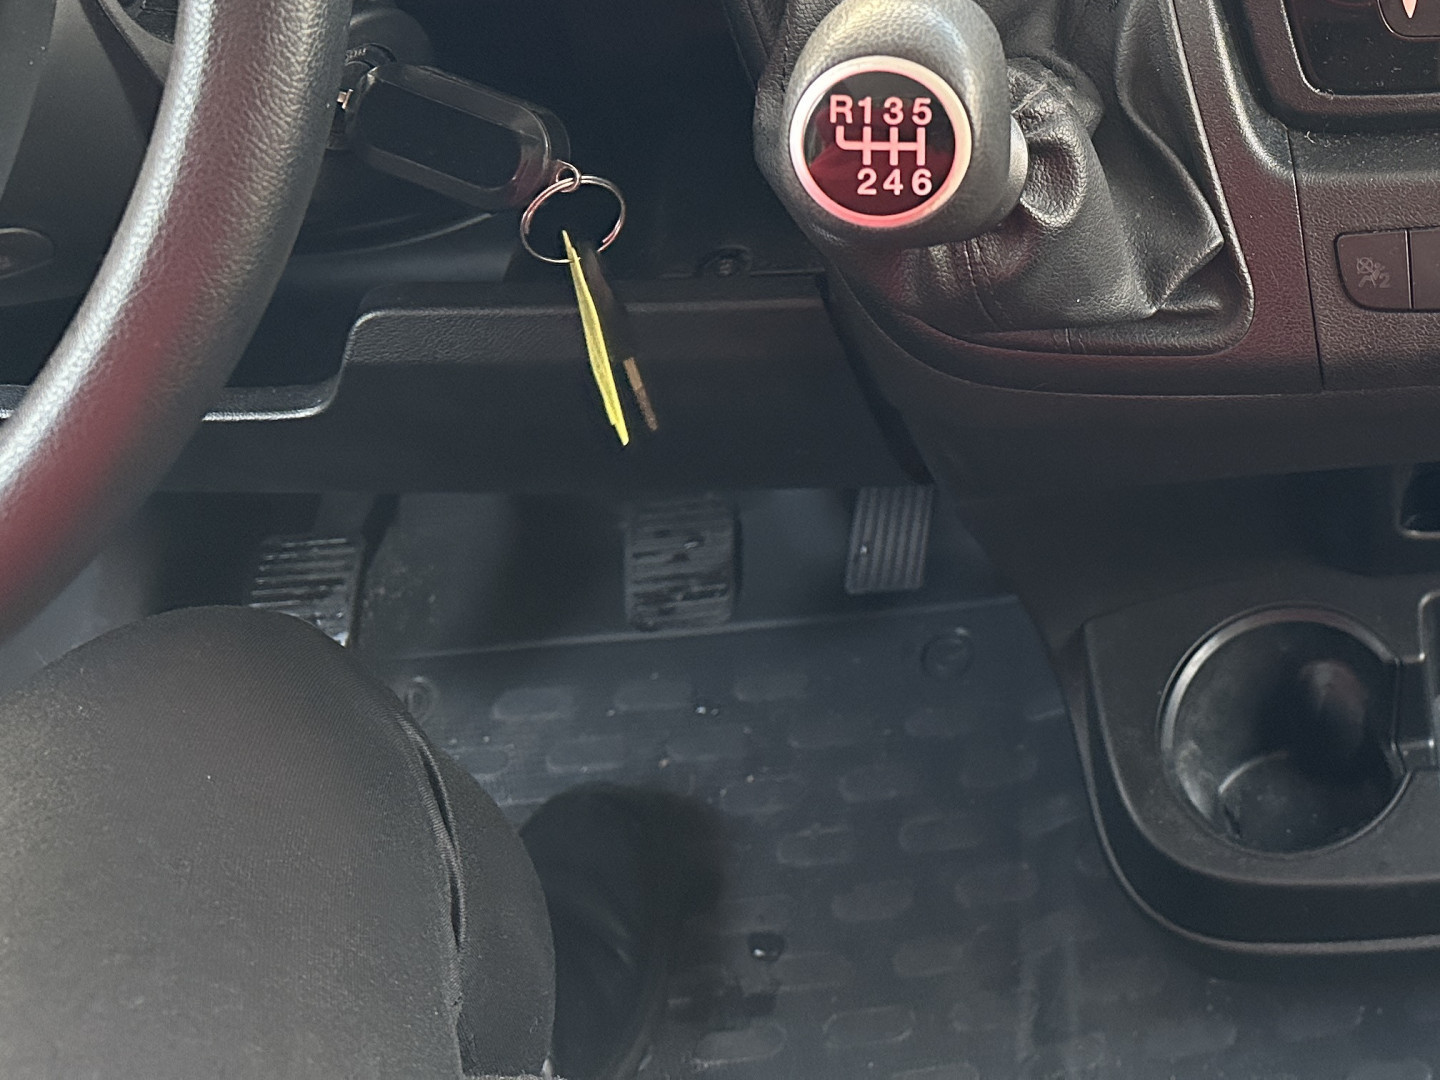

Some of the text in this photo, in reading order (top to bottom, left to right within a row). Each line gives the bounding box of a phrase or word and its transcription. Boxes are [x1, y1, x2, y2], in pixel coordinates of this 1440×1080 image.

[829, 94, 933, 125] R 1 3 5
[856, 168, 933, 196] 2 4 6
